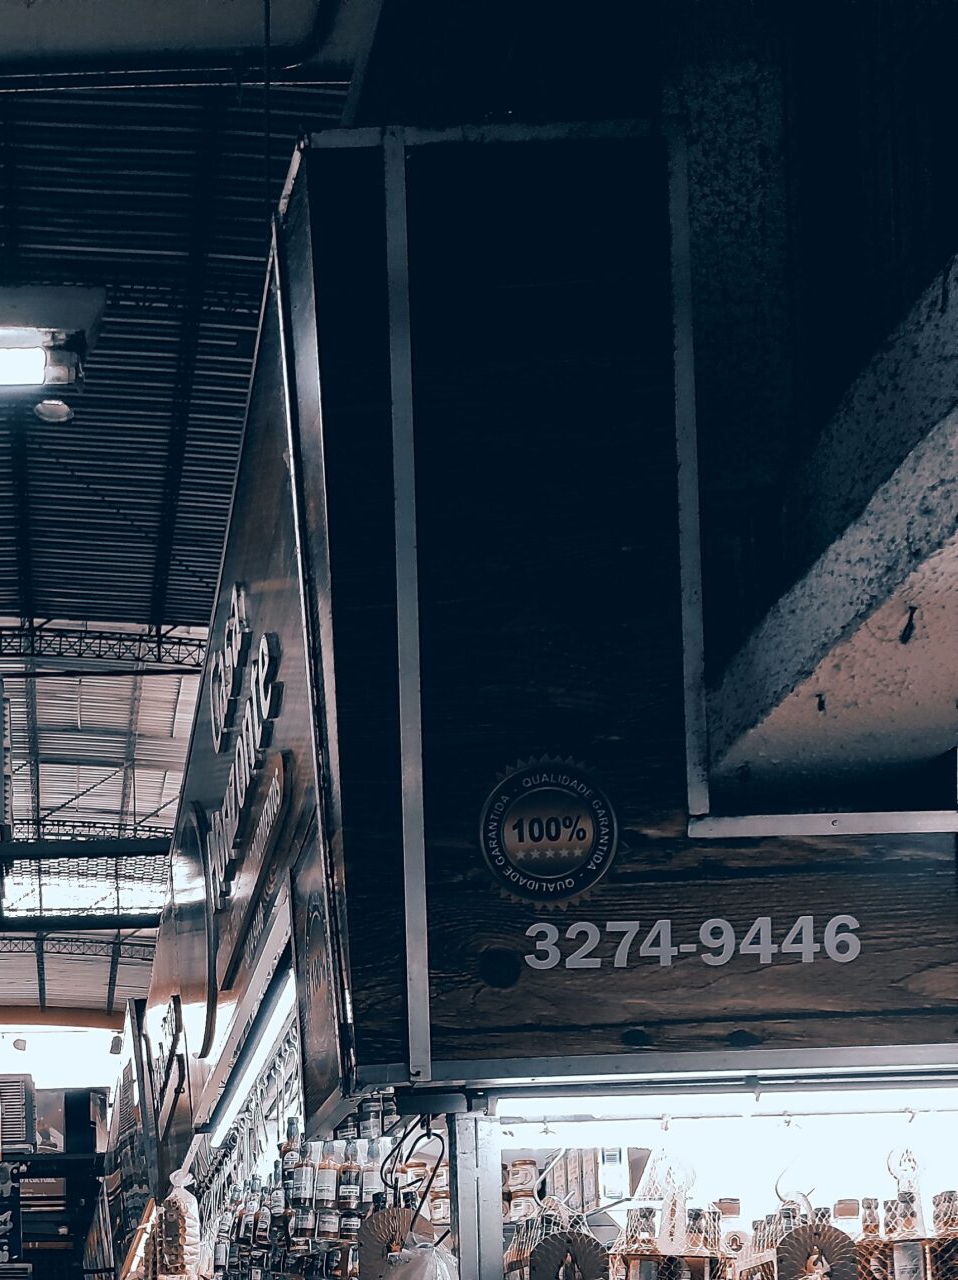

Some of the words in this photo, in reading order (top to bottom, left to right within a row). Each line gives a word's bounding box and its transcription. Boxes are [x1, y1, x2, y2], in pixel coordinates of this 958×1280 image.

[488, 795, 510, 866] GARANTIDA
[512, 816, 587, 843] 100%
[522, 774, 593, 799] QUALIDADE
[587, 800, 610, 871] GARANTIDA
[502, 866, 575, 892] QUALIDADE
[524, 914, 862, 971] 3274-9446
